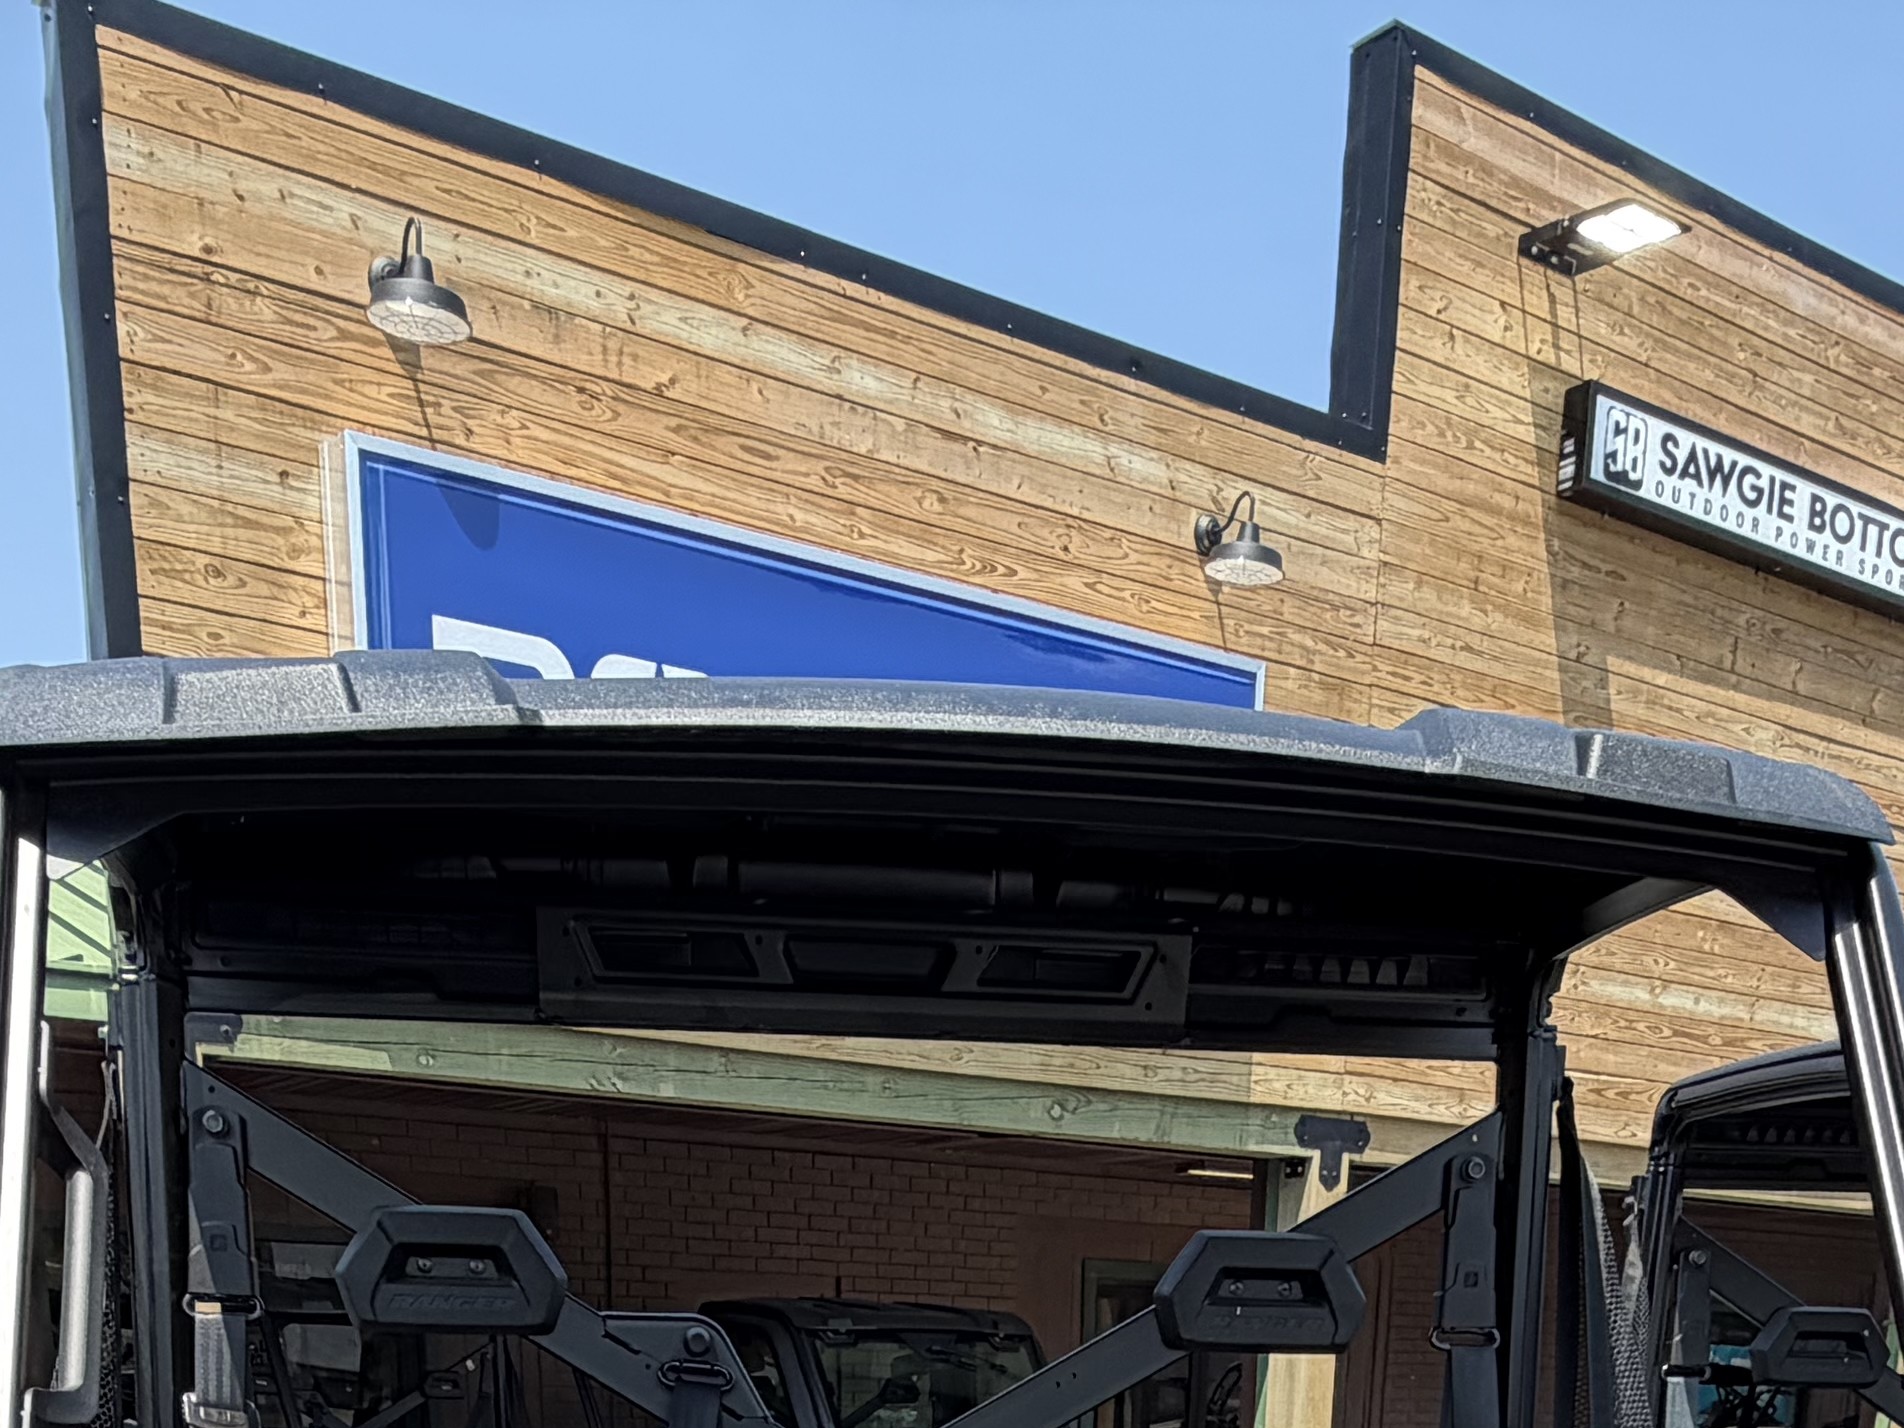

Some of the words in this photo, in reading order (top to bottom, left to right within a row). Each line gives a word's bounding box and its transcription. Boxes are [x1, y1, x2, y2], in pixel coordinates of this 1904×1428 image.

[1654, 480, 1760, 535] OUTDOOR
[1774, 525, 1844, 567] POWER
[1658, 432, 1797, 525] SAWGIE
